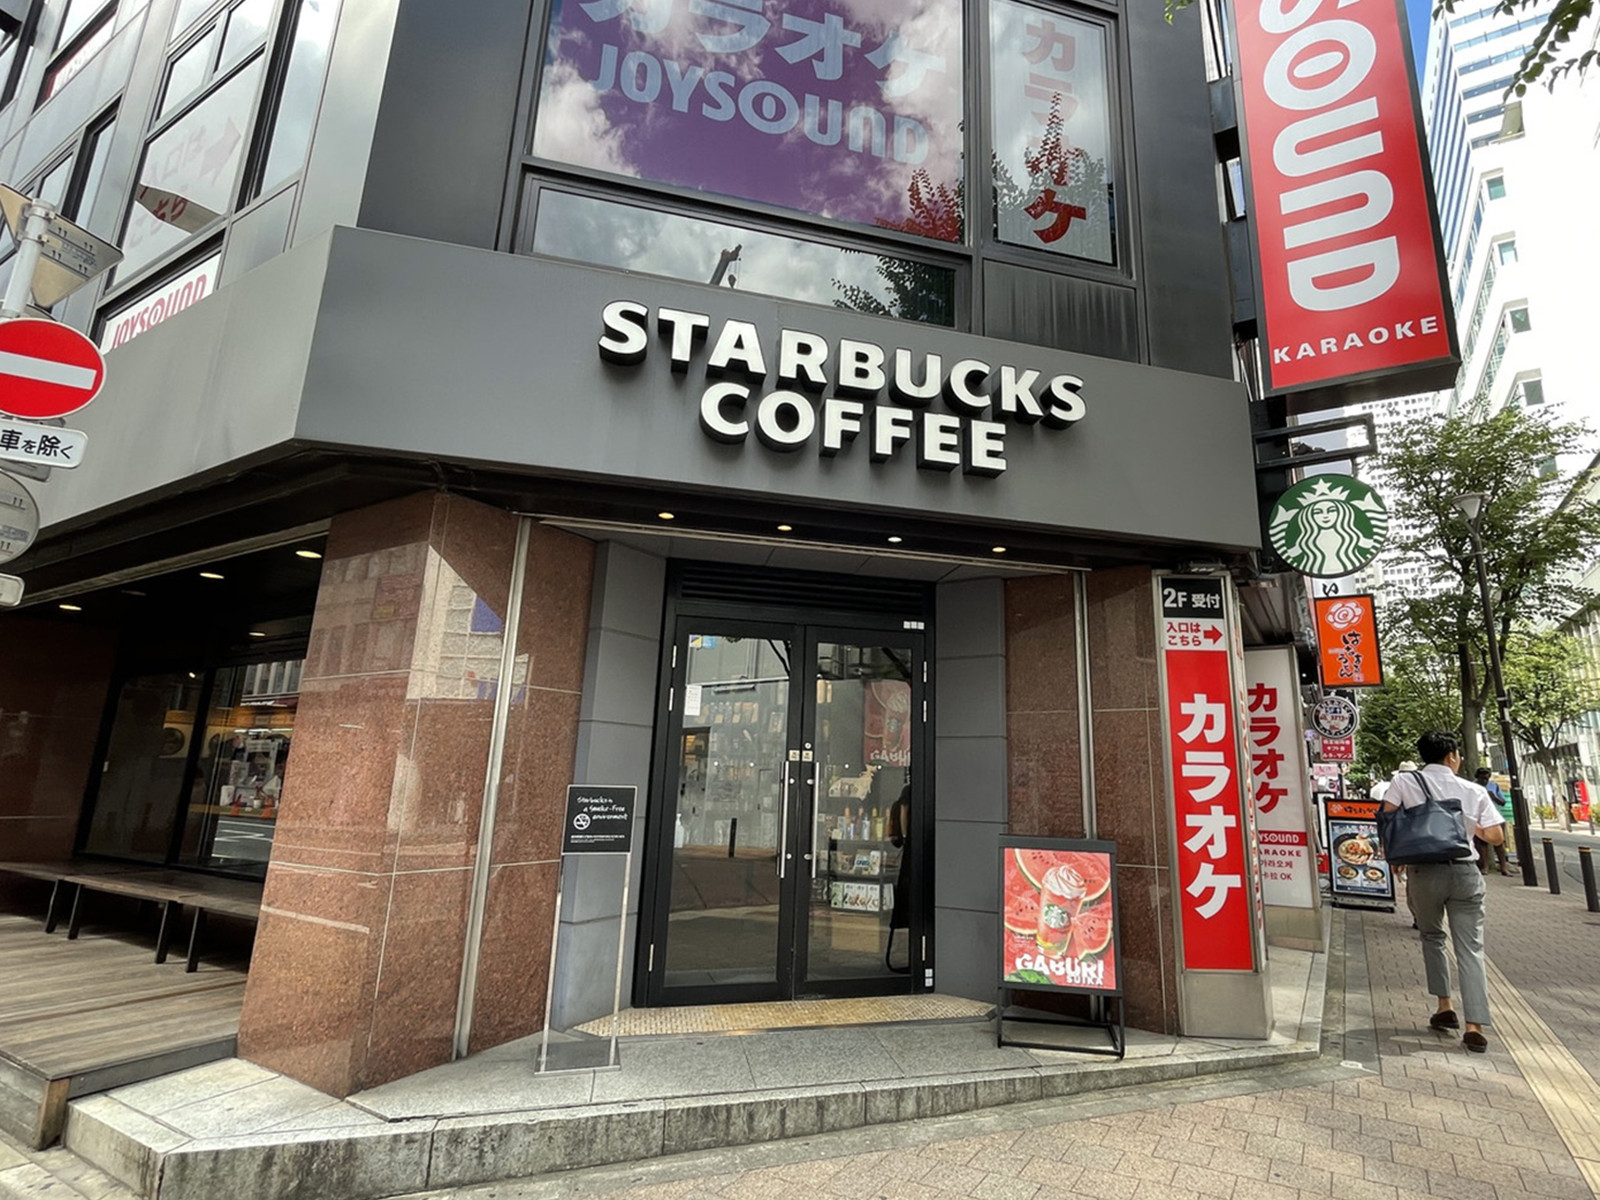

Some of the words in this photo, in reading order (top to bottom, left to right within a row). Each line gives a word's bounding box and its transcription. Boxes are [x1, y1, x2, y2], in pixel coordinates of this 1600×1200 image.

[589, 44, 929, 165] JOYSOUND
[599, 301, 1086, 425] STARBUCKS
[1273, 316, 1438, 364] KARAOKE
[701, 382, 1006, 473] COFFEE
[1163, 587, 1187, 608] 2F
[1191, 593, 1220, 608] 受付
[1166, 621, 1201, 633] 入口は
[1168, 635, 1202, 646] こちら
[1247, 682, 1288, 814] カラオケ
[1177, 693, 1242, 919] カラオケ
[1280, 872, 1293, 881] OK
[1015, 953, 1105, 979] GABURI
